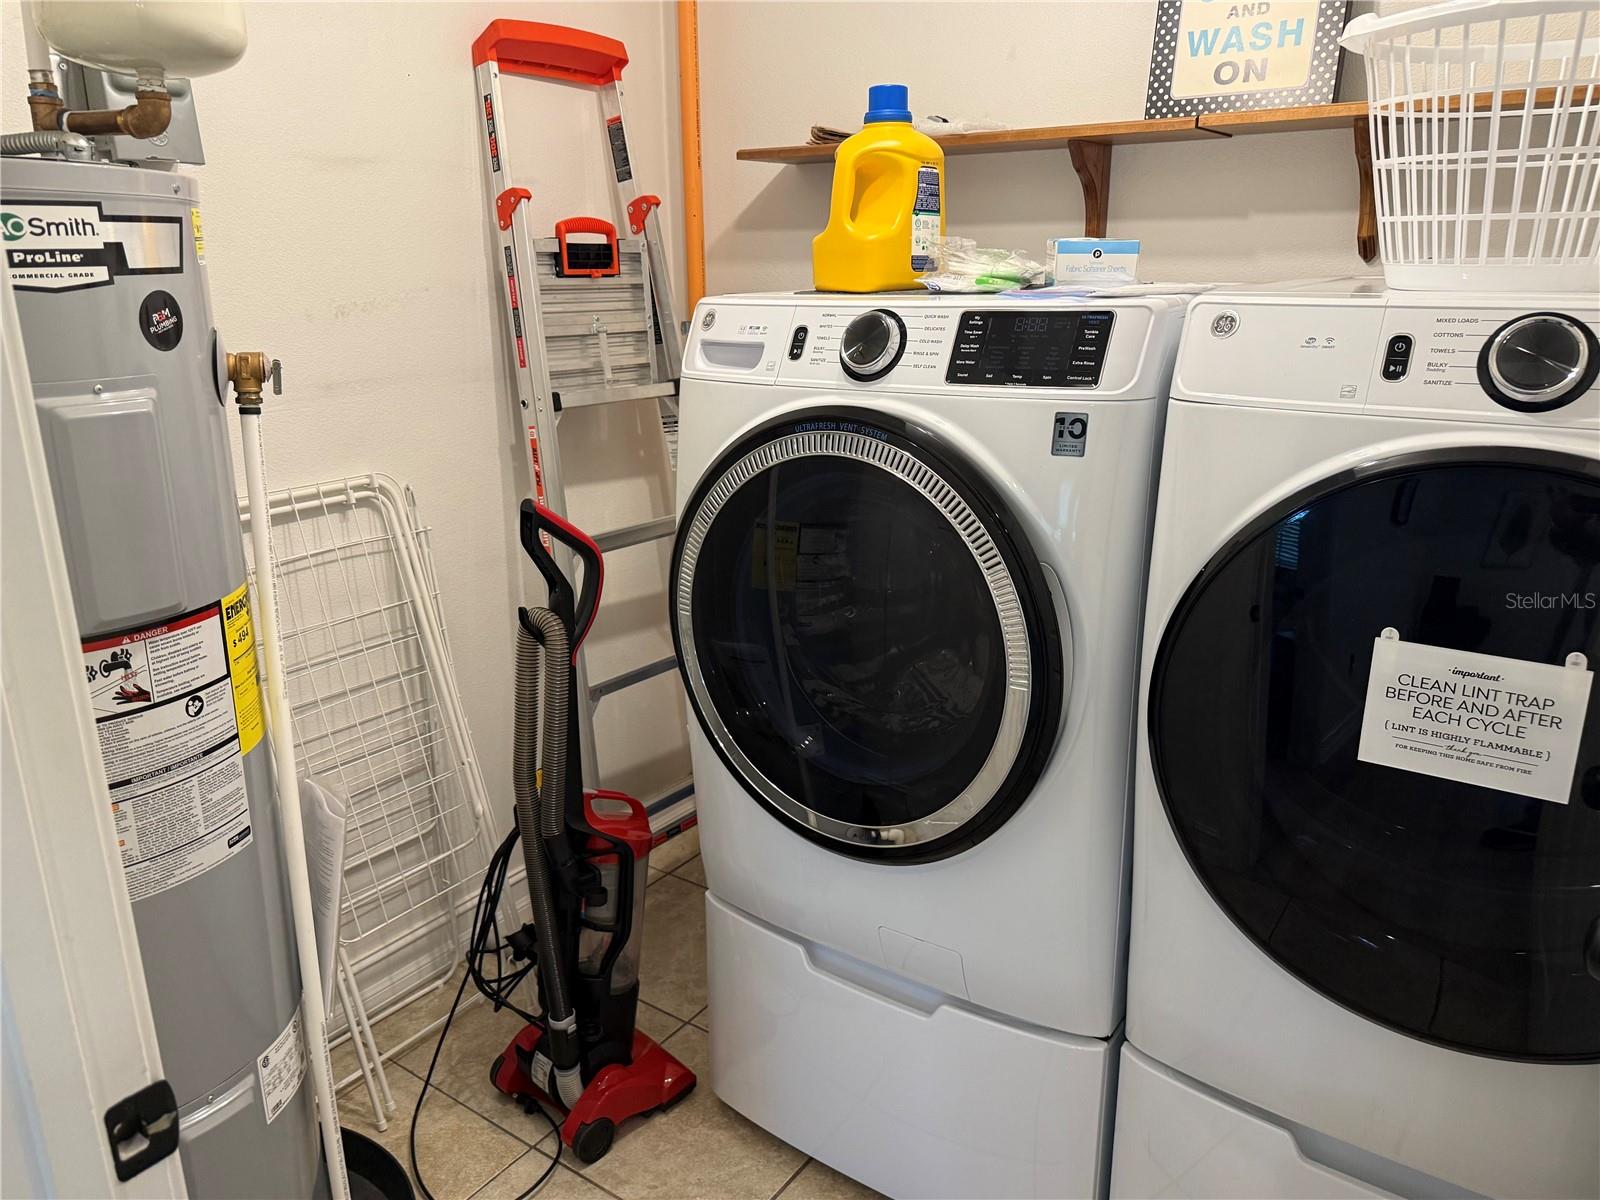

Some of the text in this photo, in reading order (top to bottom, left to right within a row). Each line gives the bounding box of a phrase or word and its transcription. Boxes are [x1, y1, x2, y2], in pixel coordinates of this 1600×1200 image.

[1226, 2, 1270, 19] AND
[1188, 18, 1305, 58] WASH
[1213, 58, 1269, 85] ON
[1066, 264, 1082, 272] Fabric
[795, 422, 888, 440] ULTRAFRESH VENT SYSTEM
[134, 626, 169, 641] DANGER
[1398, 674, 1555, 710] CLEAN LINT TRAP
[1386, 686, 1562, 730] BEFORE AND AFTER
[1412, 706, 1527, 739] EACH CYCLE
[1392, 723, 1416, 733] LINT
[1418, 728, 1429, 736] IS
[1431, 730, 1471, 744] HIGHLY
[1473, 739, 1543, 759] FLAMMABLE
[1409, 746, 1438, 756] KEEPING
[1456, 756, 1476, 764] HOME
[130, 767, 166, 783] IMPORTANT
